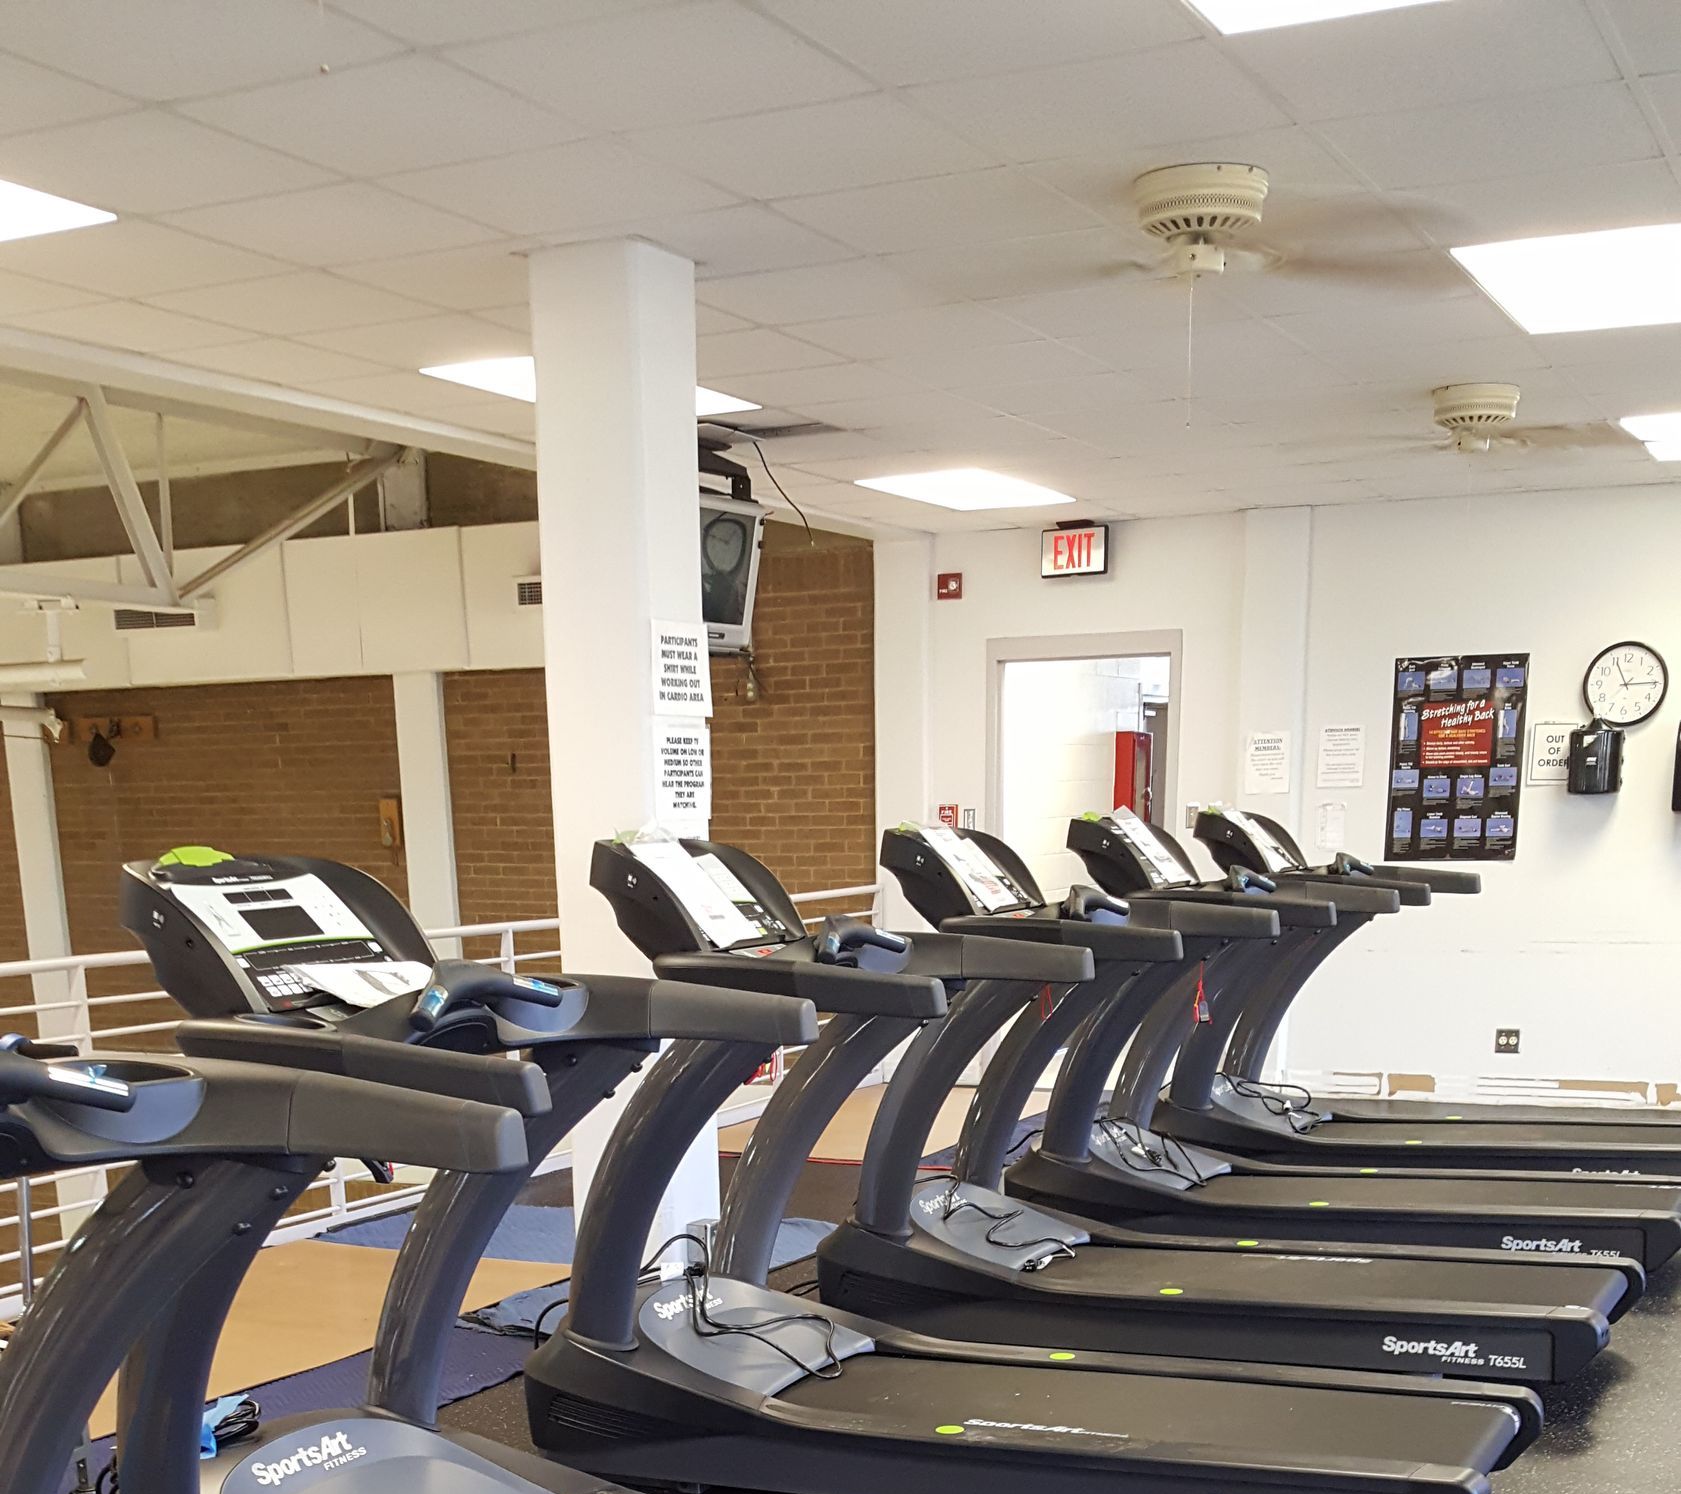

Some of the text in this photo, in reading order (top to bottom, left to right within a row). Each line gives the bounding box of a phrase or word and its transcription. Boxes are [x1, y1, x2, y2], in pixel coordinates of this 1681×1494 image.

[1053, 532, 1095, 571] EXIT
[660, 634, 698, 648] PARTICIPANTS
[661, 649, 698, 661] MUST WEAR A
[1624, 653, 1634, 663] 12
[663, 663, 697, 675] SHIRT WHILE
[1601, 666, 1611, 676] 10
[1646, 666, 1654, 676] 2
[661, 677, 701, 689] WORKING OUT
[1595, 680, 1602, 690] 9
[659, 690, 704, 702] IN CARDIO AREA
[1598, 693, 1606, 703] 8
[1644, 692, 1651, 701] 4
[1421, 703, 1466, 720] Stretching
[1466, 700, 1480, 713] for
[1480, 699, 1486, 708] a
[1609, 702, 1615, 712] 7
[1620, 706, 1627, 716] 6
[1634, 702, 1641, 712] 5
[1441, 708, 1495, 728] Healthy Back
[666, 736, 682, 745] PLEASE
[1546, 735, 1565, 744] OUT
[680, 748, 688, 756] ON
[688, 748, 697, 756] LOW
[698, 748, 705, 756] OR
[1547, 746, 1561, 756] OF
[690, 759, 703, 767] OTHER
[664, 769, 694, 777] PARTICIPANTS
[662, 780, 705, 788] HEAR THE PROGRAM
[675, 791, 685, 799] THEY
[1500, 1235, 1583, 1252] SportsArt
[1382, 1336, 1479, 1358] SportsArt
[1440, 1355, 1527, 1369] FITNESS T655L
[963, 1418, 1087, 1434] SportsArt
[251, 1431, 353, 1486] SportsArt
[323, 1446, 367, 1471] FITNESS
